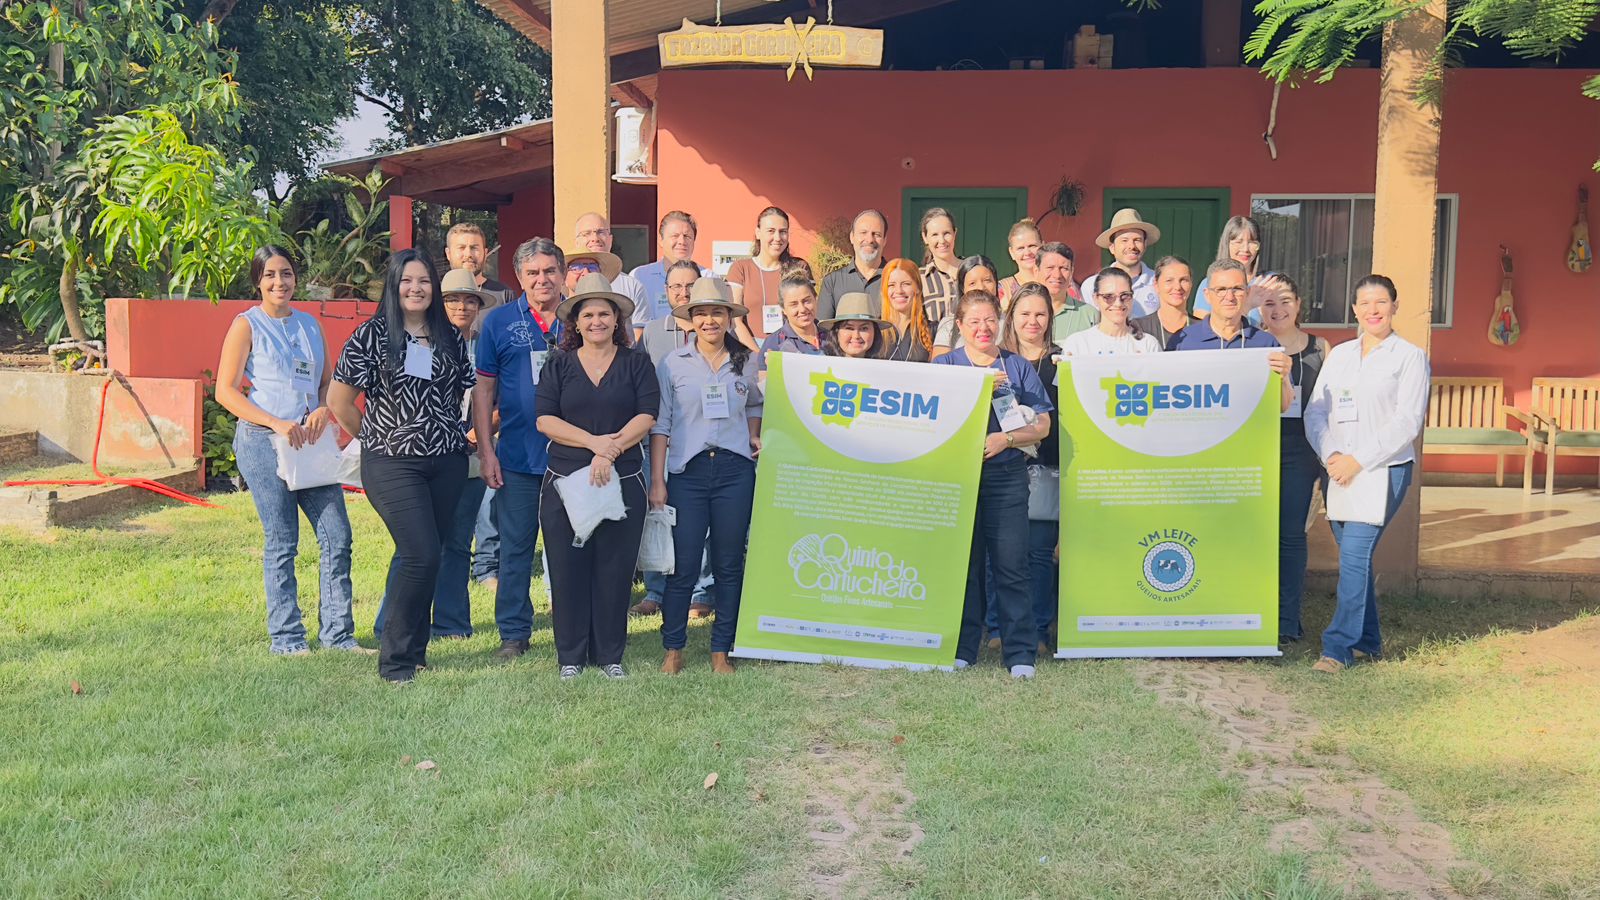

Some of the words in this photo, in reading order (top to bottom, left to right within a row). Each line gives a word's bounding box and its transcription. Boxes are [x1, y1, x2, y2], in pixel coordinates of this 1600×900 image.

[860, 387, 940, 420] ESIM
[1152, 383, 1229, 409] ESIM
[1138, 530, 1161, 548] VM
[1163, 528, 1199, 548] LEITE
[793, 559, 927, 600] Cartucheira
[1136, 580, 1162, 602] QUEIJOS
[1162, 579, 1202, 602] ARTESANAIS
